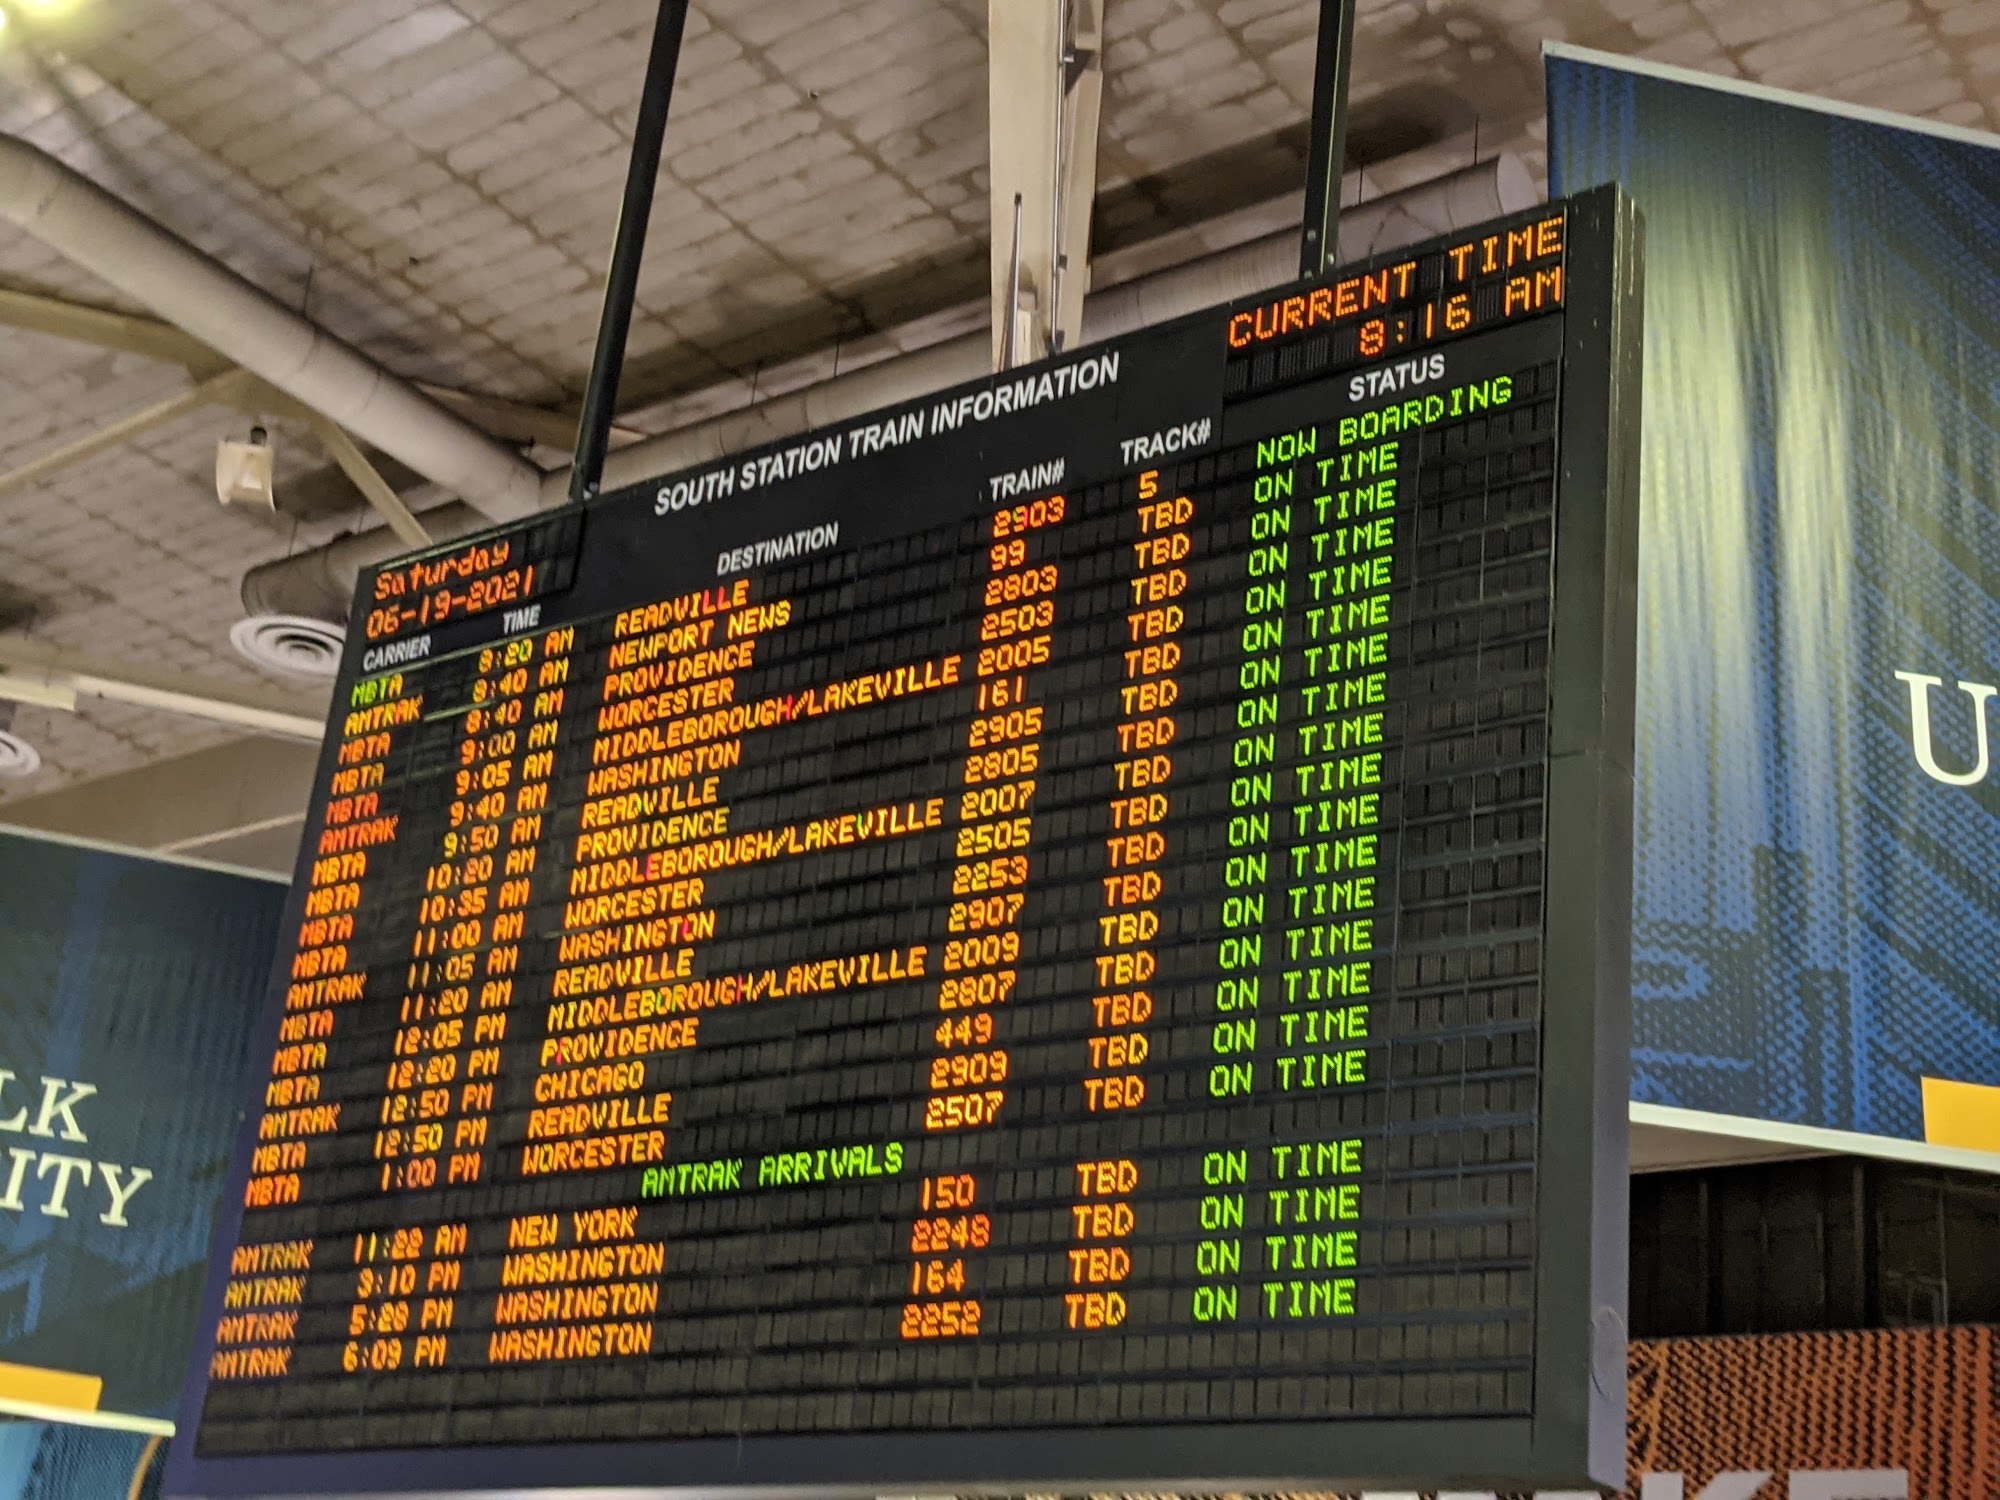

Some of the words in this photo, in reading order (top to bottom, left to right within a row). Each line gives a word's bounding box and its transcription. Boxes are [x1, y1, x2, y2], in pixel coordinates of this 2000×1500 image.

[1229, 260, 1416, 348] CURRENT
[1449, 216, 1563, 281] TIME
[1359, 292, 1471, 355] 8:16
[1504, 266, 1562, 317] AM
[655, 468, 734, 517] SOUTH
[741, 434, 842, 491] STATION
[850, 409, 924, 459] TRAIN
[931, 352, 1120, 435] INFORMATION
[1120, 417, 1211, 466] TRACK#
[1348, 353, 1446, 402] STATUS
[479, 638, 533, 673] 8:20
[544, 627, 574, 657] AM
[615, 579, 749, 638] READVILLE
[993, 496, 1065, 538] 2903
[1139, 470, 1158, 499] 5
[1257, 430, 1316, 468] NOW
[1339, 376, 1512, 446] BOARDING
[717, 521, 839, 576] DESTINATION
[989, 457, 1065, 502] TRAIN#
[366, 564, 534, 640] 06-19-2021
[374, 540, 510, 600] Saturday
[461, 730, 516, 765] 9:00
[598, 677, 734, 732] WORCESTER
[981, 600, 1054, 641] 2503
[1131, 569, 1187, 605] TBD
[1249, 543, 1288, 576] ON
[1312, 517, 1394, 562] TIME
[465, 699, 522, 734] 8:40
[604, 640, 755, 701] PROVIDENCE
[984, 565, 1058, 606] 2803
[1134, 532, 1191, 569] TBD
[1252, 506, 1290, 540] ON
[1314, 479, 1396, 524] TIME
[473, 668, 527, 705] 8:40
[609, 619, 714, 670] NEWPORT
[726, 600, 791, 640] NEWS
[990, 539, 1026, 571] 99
[1138, 497, 1193, 533] TBD
[1255, 470, 1293, 503] ON
[1317, 442, 1398, 487] TIME
[503, 604, 542, 635] TIME
[363, 634, 431, 672] CARRIER
[450, 791, 506, 827] 9:40
[587, 739, 740, 796] WASHINGTON
[977, 675, 1023, 711] 161
[1125, 642, 1181, 679] TBD
[1243, 619, 1282, 652] ON
[1307, 594, 1390, 638] TIME
[456, 760, 512, 796] 9:05
[593, 655, 961, 765] MIDDLEBOROUGH/LAKEVILLE
[977, 635, 1051, 676] 2005
[1128, 605, 1183, 641] TBD
[1246, 580, 1285, 614] ON
[1309, 555, 1392, 600] TIME
[426, 854, 493, 892] 10:20
[575, 807, 730, 863] PROVIDENCE
[964, 743, 1039, 783] 2805
[1118, 716, 1176, 753] TBD
[1238, 695, 1277, 728] ON
[1302, 672, 1386, 715] TIME
[444, 823, 499, 858] 9:50
[580, 776, 719, 829] READVILLE
[969, 707, 1043, 748] 2905
[1121, 679, 1178, 714] TBD
[1240, 656, 1280, 689] ON
[1304, 633, 1388, 677] TIME
[1894, 669, 1998, 786] U
[414, 919, 482, 957] 11:00
[563, 878, 704, 932] WORCESTER
[956, 817, 1031, 857] 2505
[1110, 793, 1167, 829] TBD
[1231, 773, 1271, 806] ON
[1296, 753, 1381, 796] TIME
[569, 798, 944, 896] MIDDLEBOROUGH/LAKEVILLE
[960, 780, 1035, 820] 2007
[1114, 755, 1171, 791] TBD
[1234, 733, 1274, 767] ON
[1299, 713, 1383, 755] TIME
[401, 986, 469, 1022] 11:20
[553, 948, 694, 997] READVILLE
[948, 893, 1024, 932] 2907
[1103, 871, 1162, 907] TBD
[1226, 853, 1266, 887] ON
[1291, 834, 1377, 877] TIME
[408, 952, 475, 988] 11:05
[559, 909, 717, 962] WASHINGTON
[953, 855, 1028, 895] 2253
[1107, 831, 1165, 868] TBD
[1229, 812, 1269, 846] ON
[1294, 793, 1379, 836] TIME
[387, 1054, 457, 1090] 12:20
[541, 1017, 699, 1067] PROVIDENCE
[939, 970, 1016, 1010] 2807
[1096, 950, 1155, 987] TBD
[1220, 935, 1261, 969] ON
[1286, 919, 1373, 960] TIME
[394, 1019, 463, 1056] 12:05
[474, 1012, 506, 1043] PM
[548, 946, 927, 1032] MIDDLEBOROUGH/LAKEVILLE
[943, 931, 1020, 971] 2009
[1100, 910, 1158, 946] TBD
[1223, 893, 1264, 927] ON
[1289, 877, 1375, 918] TIME
[374, 1123, 443, 1159] 12:50
[527, 1093, 672, 1139] READVILLE
[930, 1050, 1008, 1090] 2909
[1088, 1033, 1148, 1069] TBD
[1213, 1019, 1256, 1053] ON
[1280, 1005, 1368, 1046] TIME
[381, 1088, 450, 1124] 12:50
[534, 1061, 645, 1103] CHICAGO
[935, 1013, 994, 1049] 449
[1093, 991, 1152, 1028] TBD
[1217, 976, 1258, 1011] ON
[1283, 962, 1371, 1003] TIME
[382, 1157, 436, 1191] 1:00
[522, 1130, 665, 1175] WORCESTER
[925, 1090, 1004, 1130] 2507
[1084, 1075, 1145, 1111] TBD
[1210, 1063, 1252, 1096] ON
[1277, 1050, 1366, 1090] TIME
[509, 1215, 560, 1249] NEW
[574, 1207, 638, 1242] YORK
[921, 1174, 976, 1211] 150
[1077, 1160, 1138, 1197] TBD
[1204, 1151, 1246, 1184] ON
[1272, 1139, 1362, 1179] TIME
[759, 1142, 903, 1185] ARRIVALS
[495, 1283, 658, 1324] WASHINGTON
[911, 1259, 965, 1295] 164
[1069, 1247, 1131, 1284] TBD
[1197, 1241, 1240, 1275] ON
[1266, 1231, 1357, 1271] TIME
[502, 1243, 664, 1286] WASHINGTON
[911, 1214, 991, 1253] 2248
[1072, 1202, 1135, 1239] TBD
[1201, 1195, 1243, 1229] ON
[1269, 1185, 1360, 1225] TIME
[342, 1338, 402, 1372] 6:09
[488, 1322, 652, 1363] WASHINGTON
[901, 1300, 981, 1339] 2252
[1065, 1292, 1126, 1329] TBD
[1193, 1286, 1237, 1321] ON
[1264, 1279, 1355, 1318] TIME
